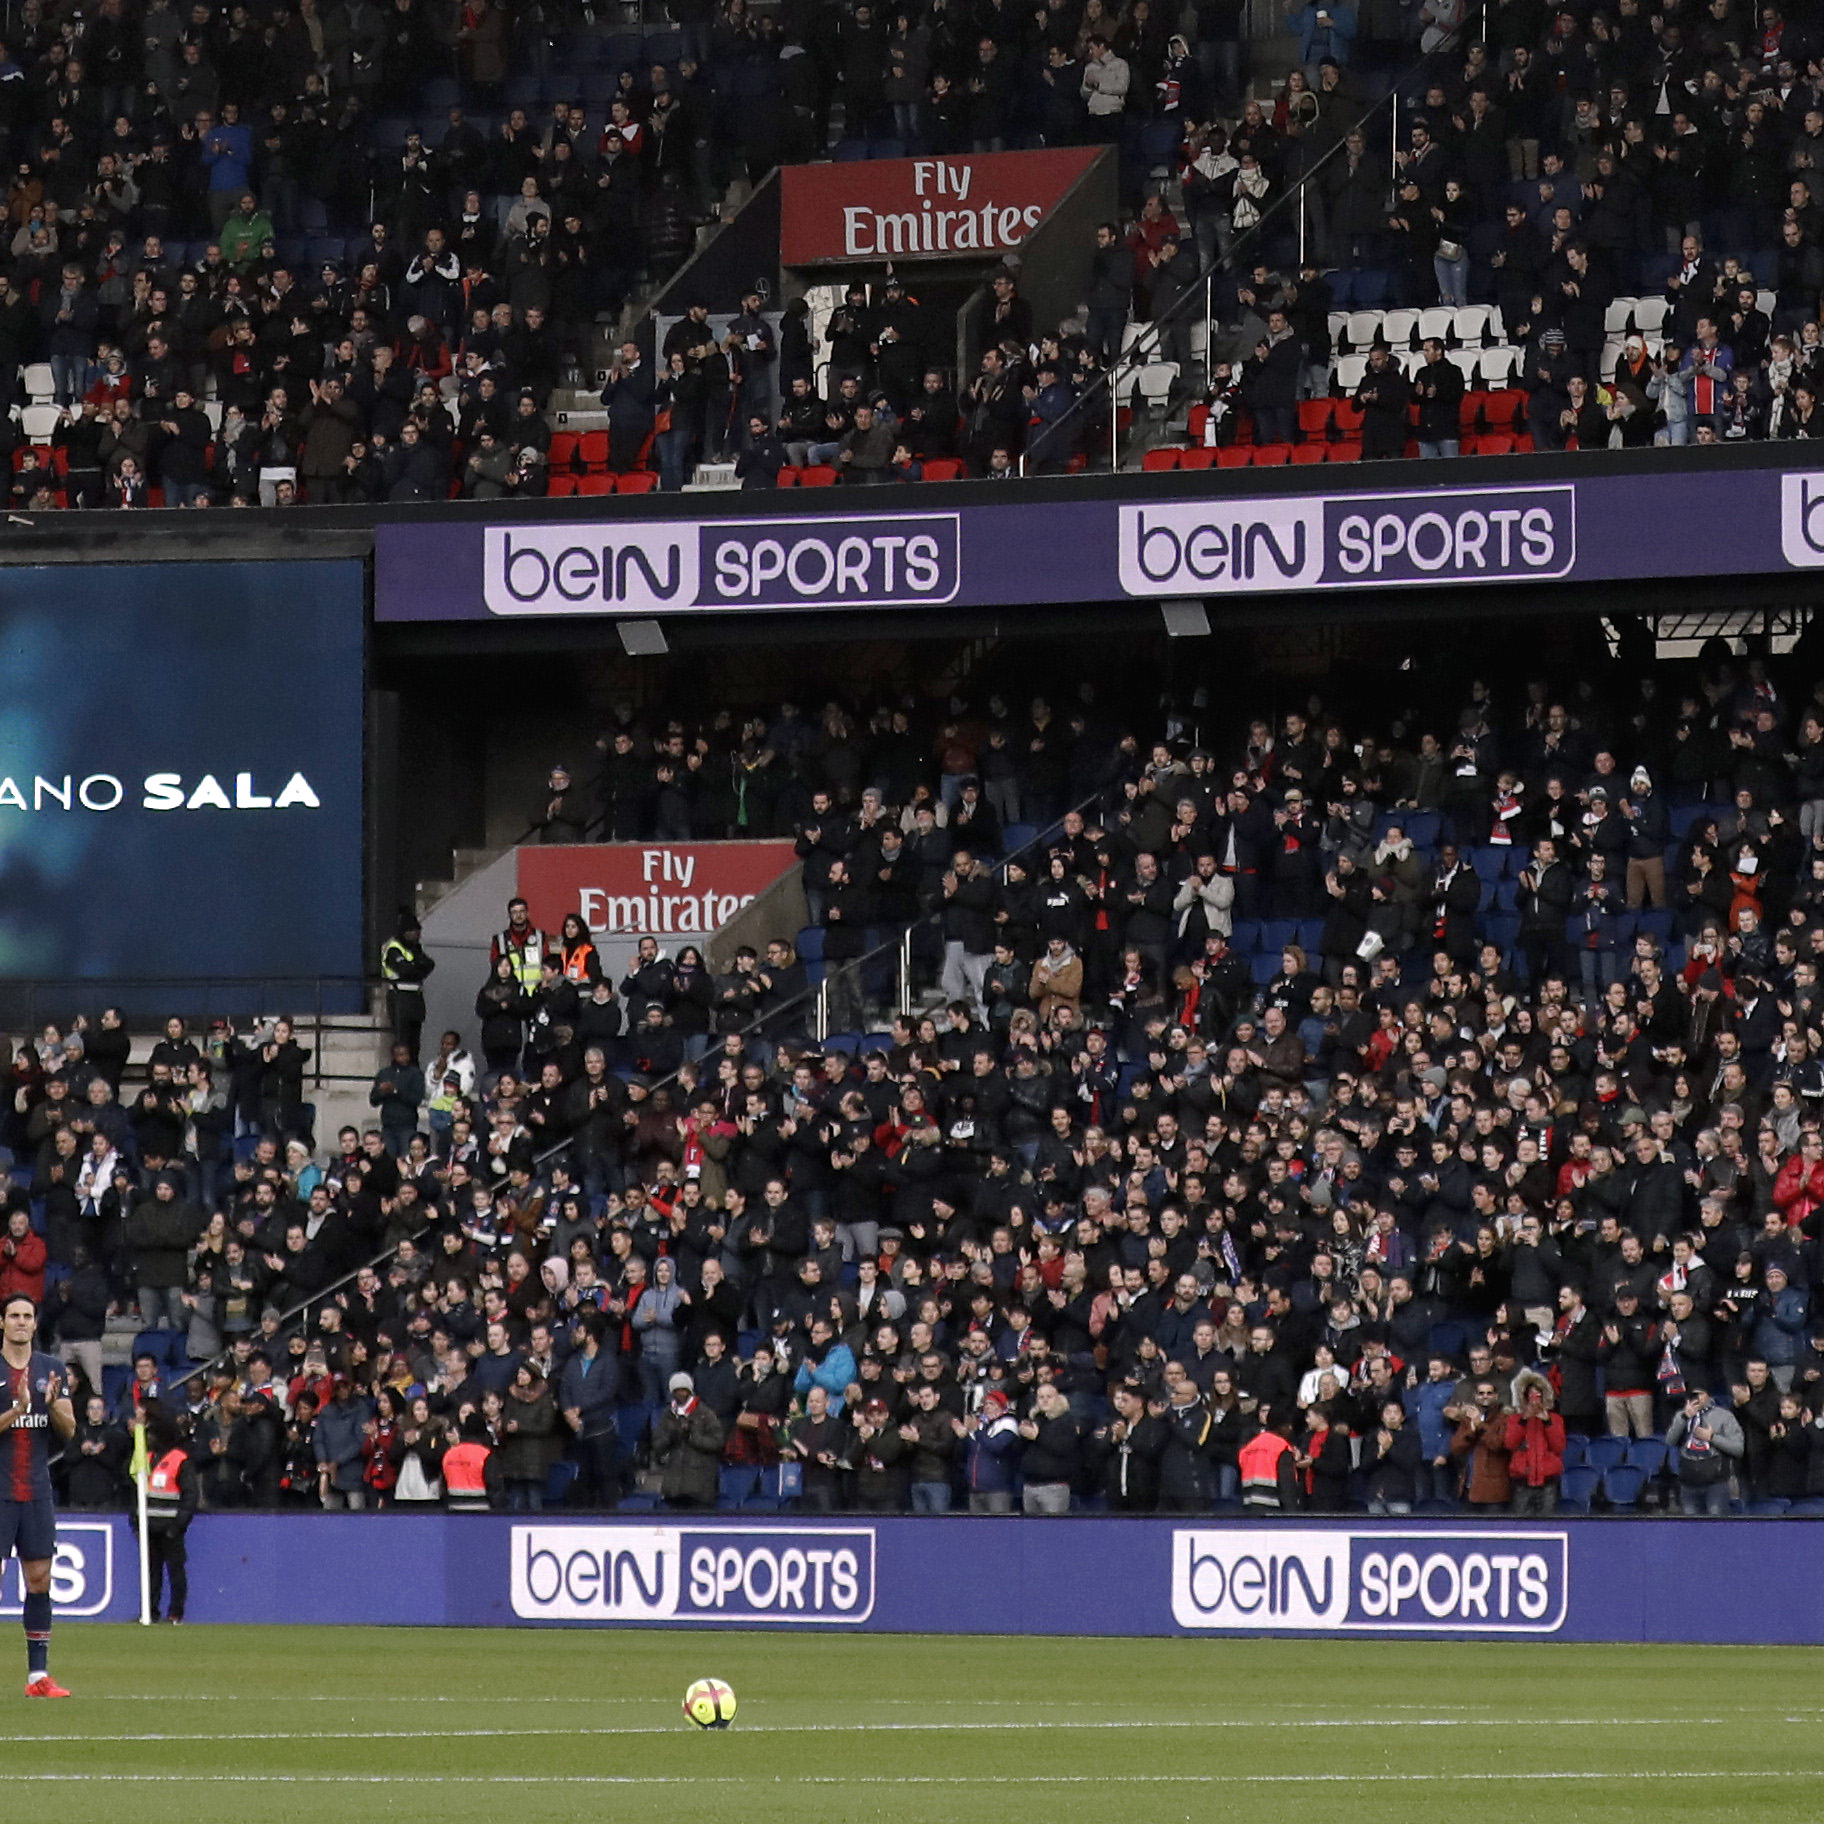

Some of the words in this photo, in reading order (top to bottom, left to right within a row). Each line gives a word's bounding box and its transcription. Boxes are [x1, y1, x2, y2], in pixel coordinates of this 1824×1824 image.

[913, 161, 972, 201] Fly
[842, 199, 1042, 256] Emirates
[501, 531, 683, 603] beIN
[714, 534, 940, 598] SPORTS
[1135, 510, 1308, 583] beIN
[1337, 507, 1555, 574] SPORTS
[143, 773, 320, 810] SALA
[642, 850, 695, 888] Fly
[578, 884, 757, 933] Emirate
[525, 1533, 665, 1607] beIN
[690, 1546, 859, 1610] SPORTS
[1189, 1537, 1335, 1616] beIN
[1360, 1552, 1549, 1619] SPORTS
